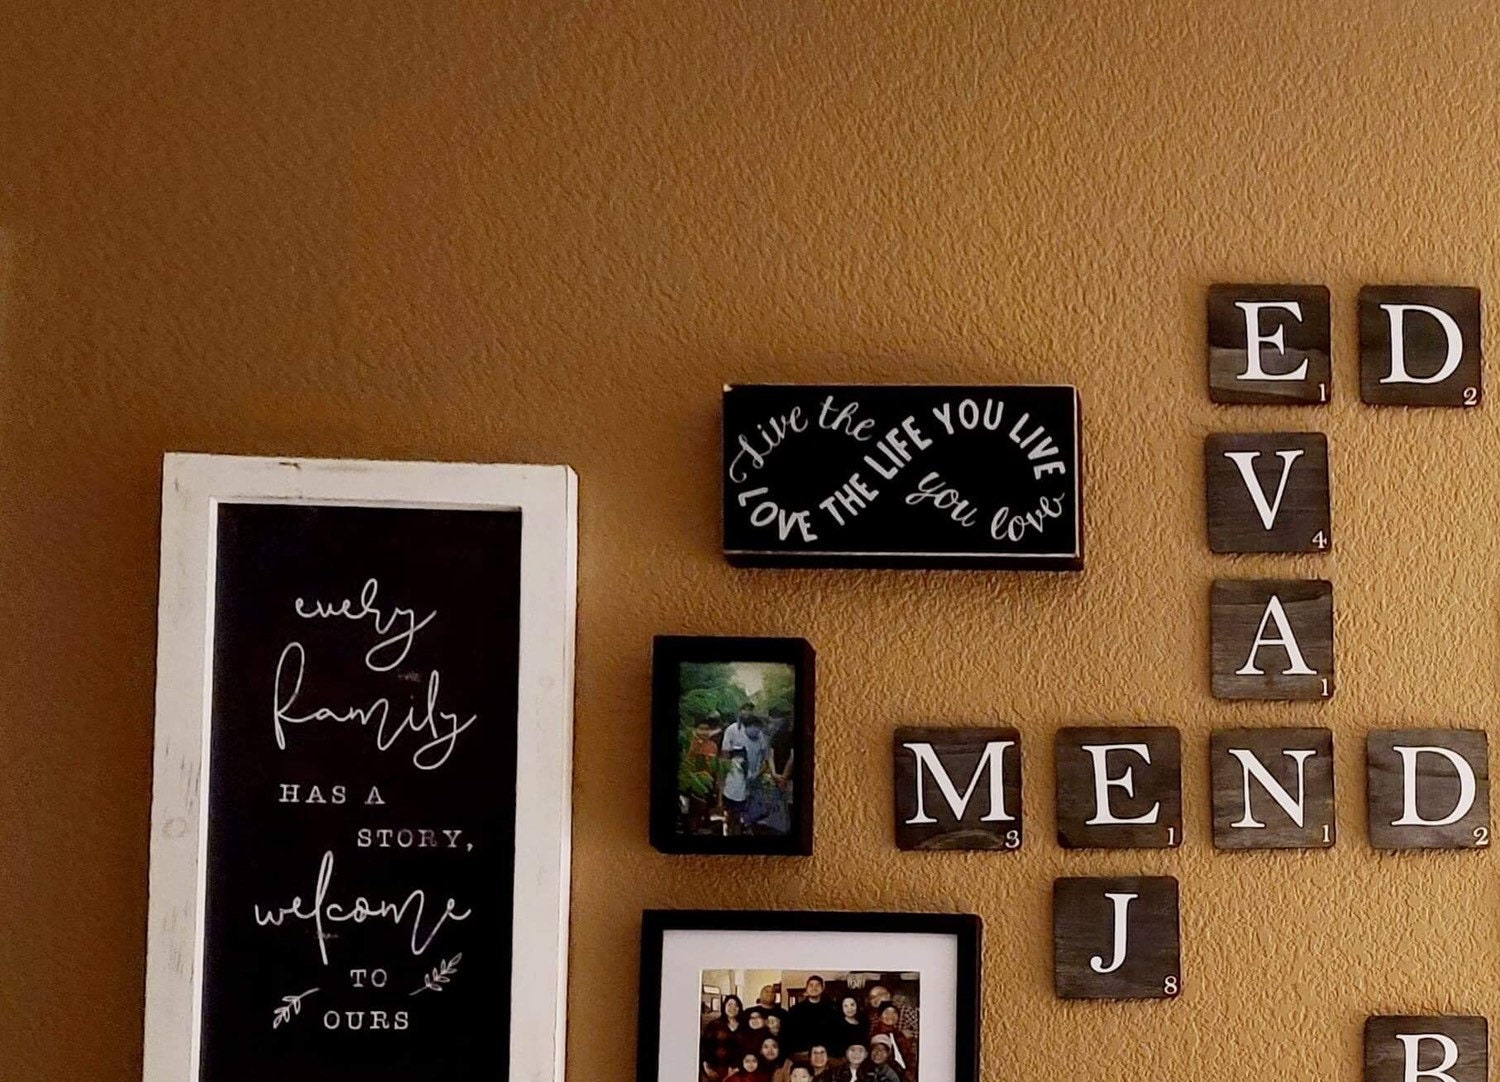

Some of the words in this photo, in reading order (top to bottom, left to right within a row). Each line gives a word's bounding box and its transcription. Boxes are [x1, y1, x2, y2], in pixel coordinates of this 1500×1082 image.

[1463, 387, 1478, 405] 2
[729, 405, 809, 483] Live
[818, 395, 876, 442] the
[737, 486, 818, 543] LOVE
[818, 472, 880, 526] THE
[863, 415, 933, 480] LIFE
[932, 398, 1005, 435] YOU
[1008, 412, 1066, 481] LIVE
[904, 471, 978, 527] you
[990, 491, 1066, 542] love
[1311, 530, 1325, 549] 4
[294, 577, 437, 672] every
[273, 641, 478, 771] family
[278, 783, 347, 805] HAS
[364, 785, 386, 805] A
[357, 828, 474, 852] STORY,
[1004, 830, 1021, 848] 3
[1472, 826, 1490, 846] 2
[254, 850, 472, 966] welcome
[350, 968, 388, 988] TO
[1163, 975, 1179, 994] 8
[323, 1010, 409, 1030] OURS
